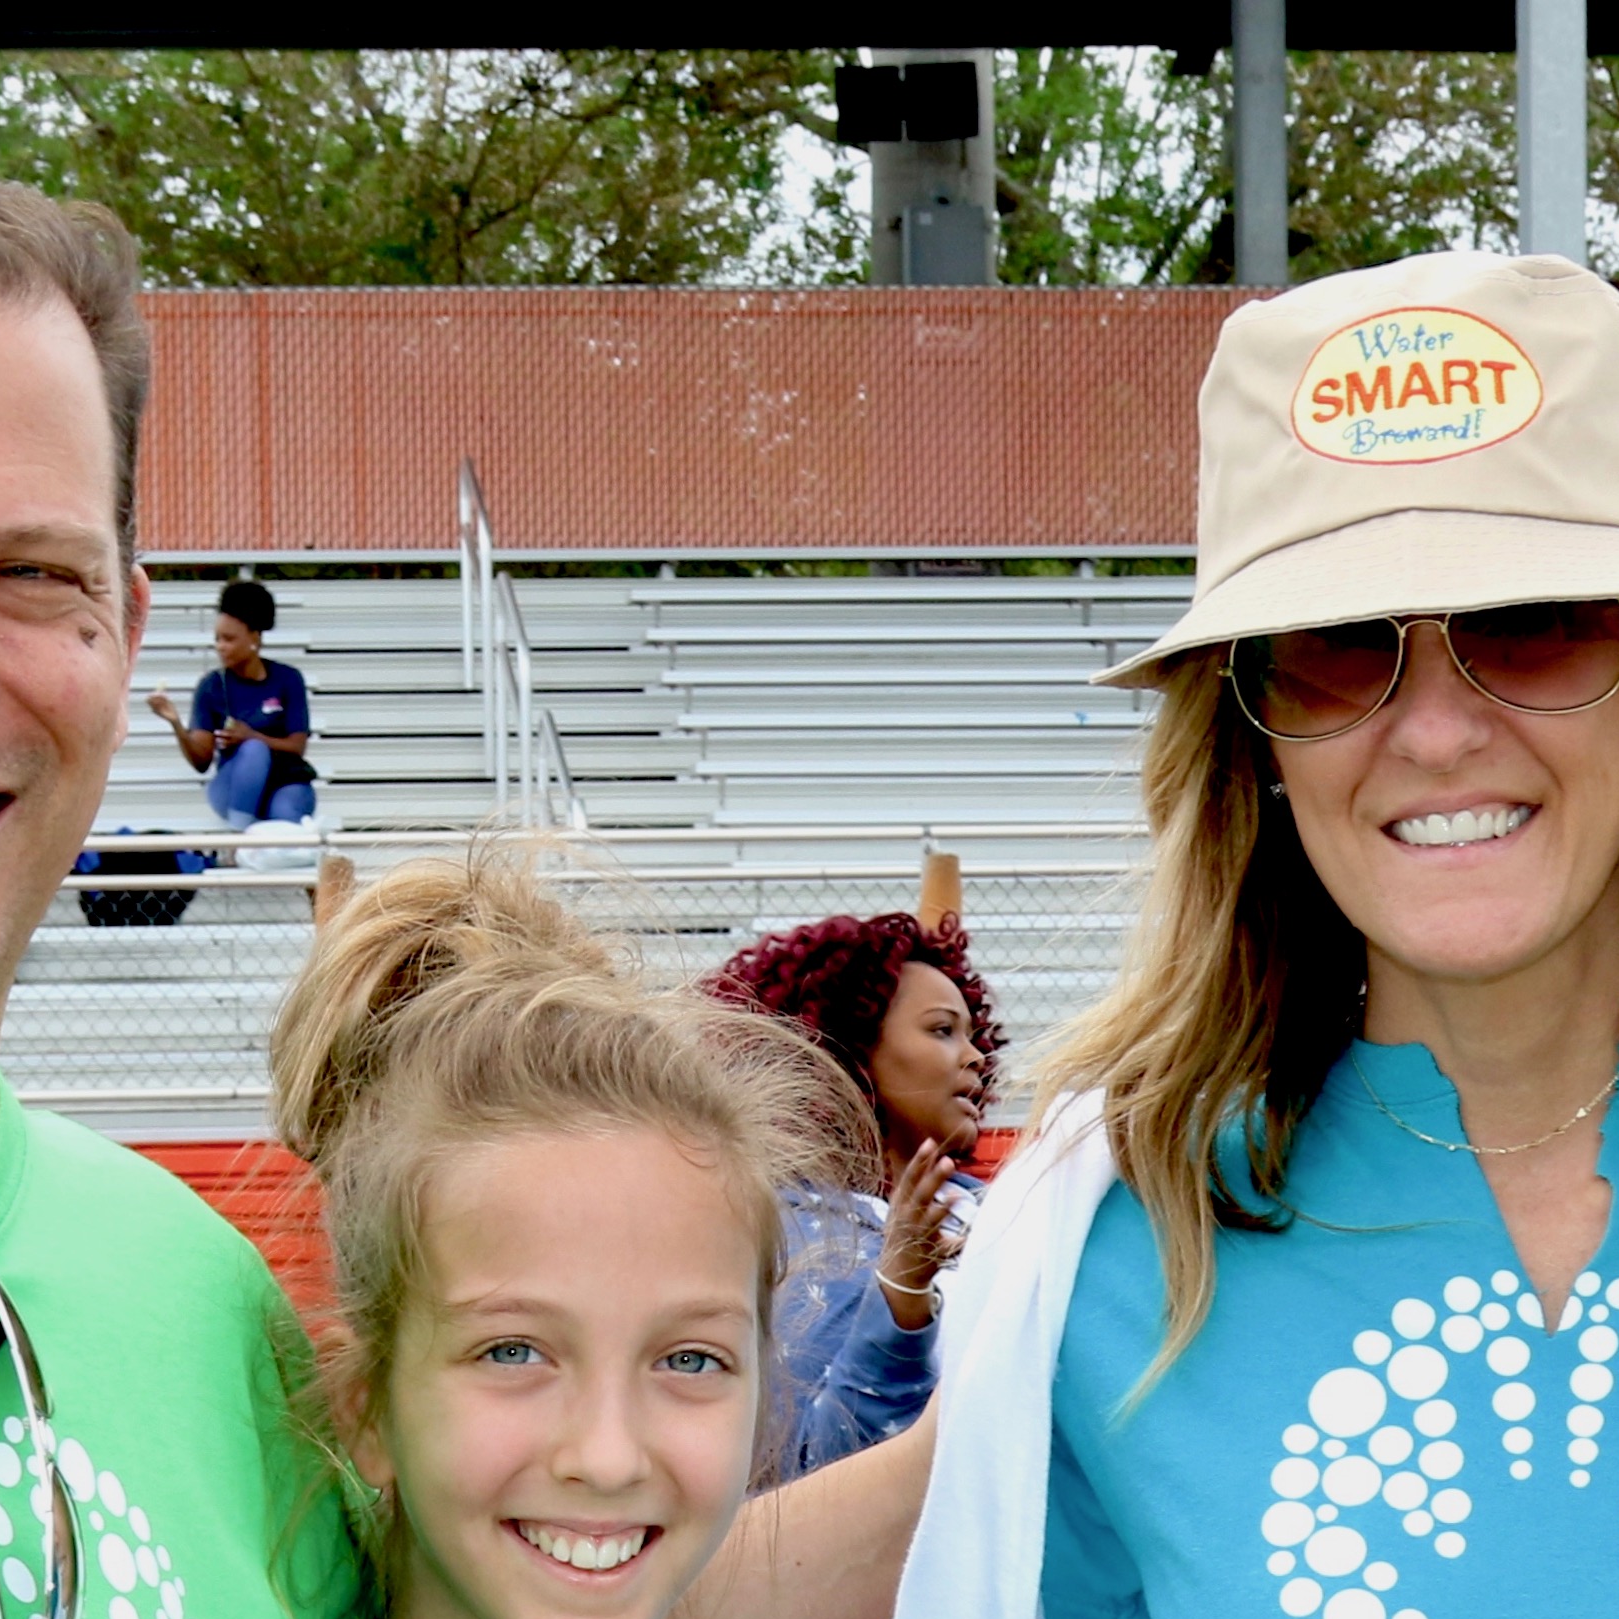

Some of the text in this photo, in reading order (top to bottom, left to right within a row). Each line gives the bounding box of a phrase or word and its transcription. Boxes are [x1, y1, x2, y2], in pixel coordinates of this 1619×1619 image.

[1351, 322, 1454, 362] Water
[1311, 359, 1517, 424] SMART
[1343, 408, 1486, 455] Broward!
